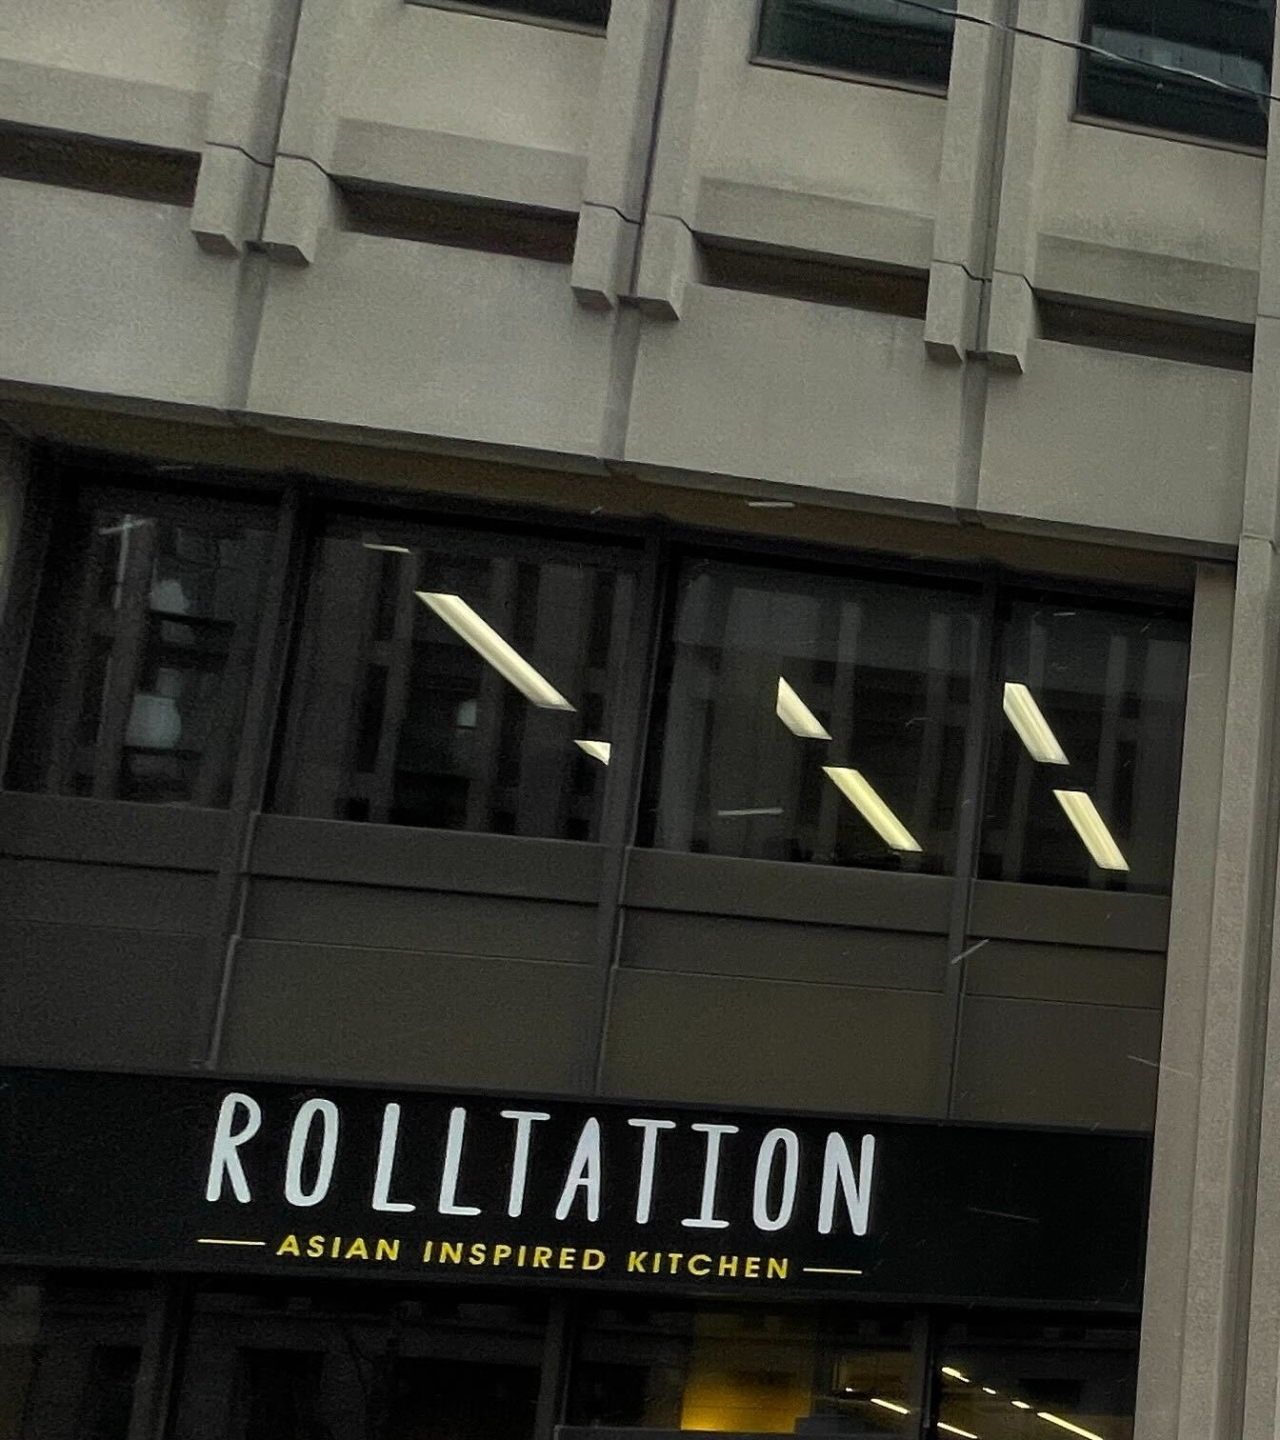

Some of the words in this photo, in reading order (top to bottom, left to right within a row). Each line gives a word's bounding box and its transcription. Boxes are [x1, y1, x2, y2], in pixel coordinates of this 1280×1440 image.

[206, 1092, 876, 1237] ROLLTATION
[276, 1235, 400, 1263] ASIAN
[423, 1241, 605, 1272] INSPIRED
[628, 1251, 789, 1279] KITCHEN
